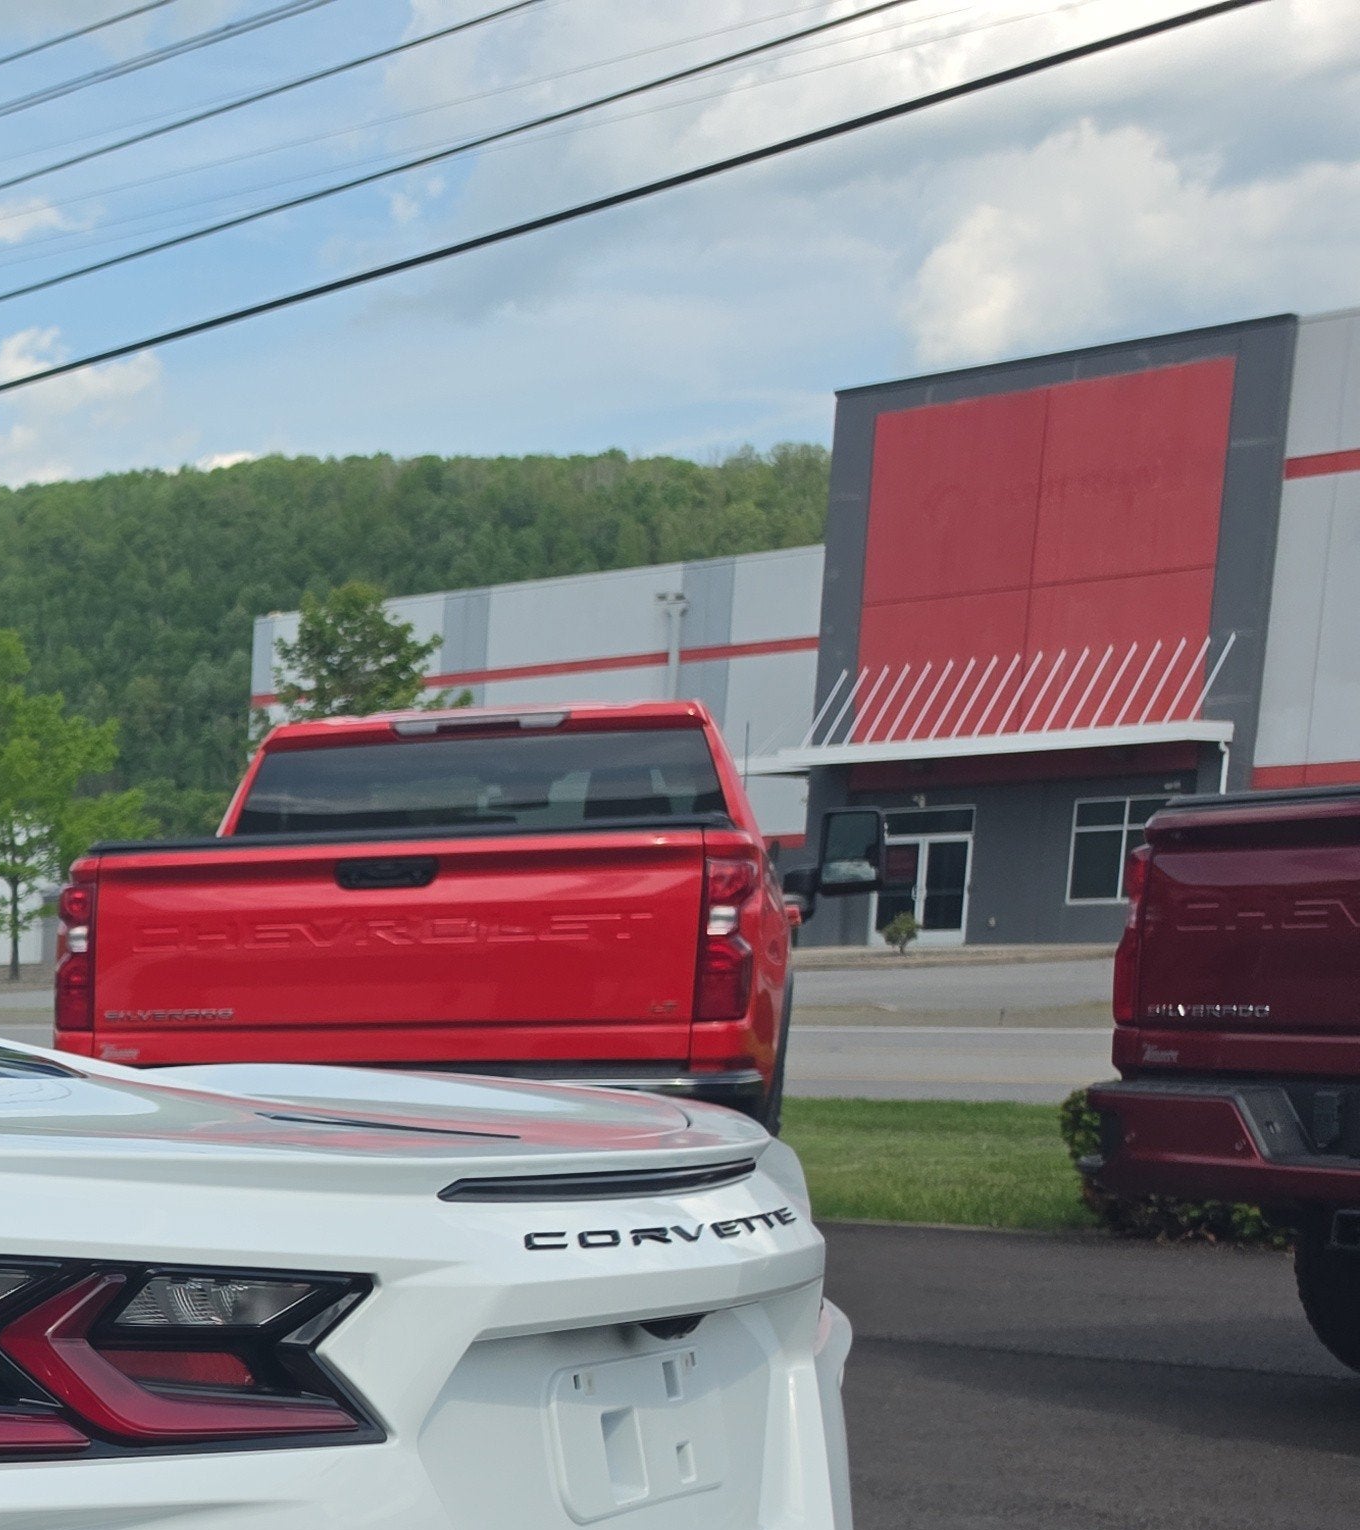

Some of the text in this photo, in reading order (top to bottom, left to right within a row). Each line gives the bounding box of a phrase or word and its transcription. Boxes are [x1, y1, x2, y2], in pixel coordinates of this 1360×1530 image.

[132, 912, 654, 952] CHEVROLET
[104, 1008, 233, 1022] SILVERADO
[1147, 1003, 1270, 1018] SILVERADO
[523, 1206, 797, 1251] CORVETTE
